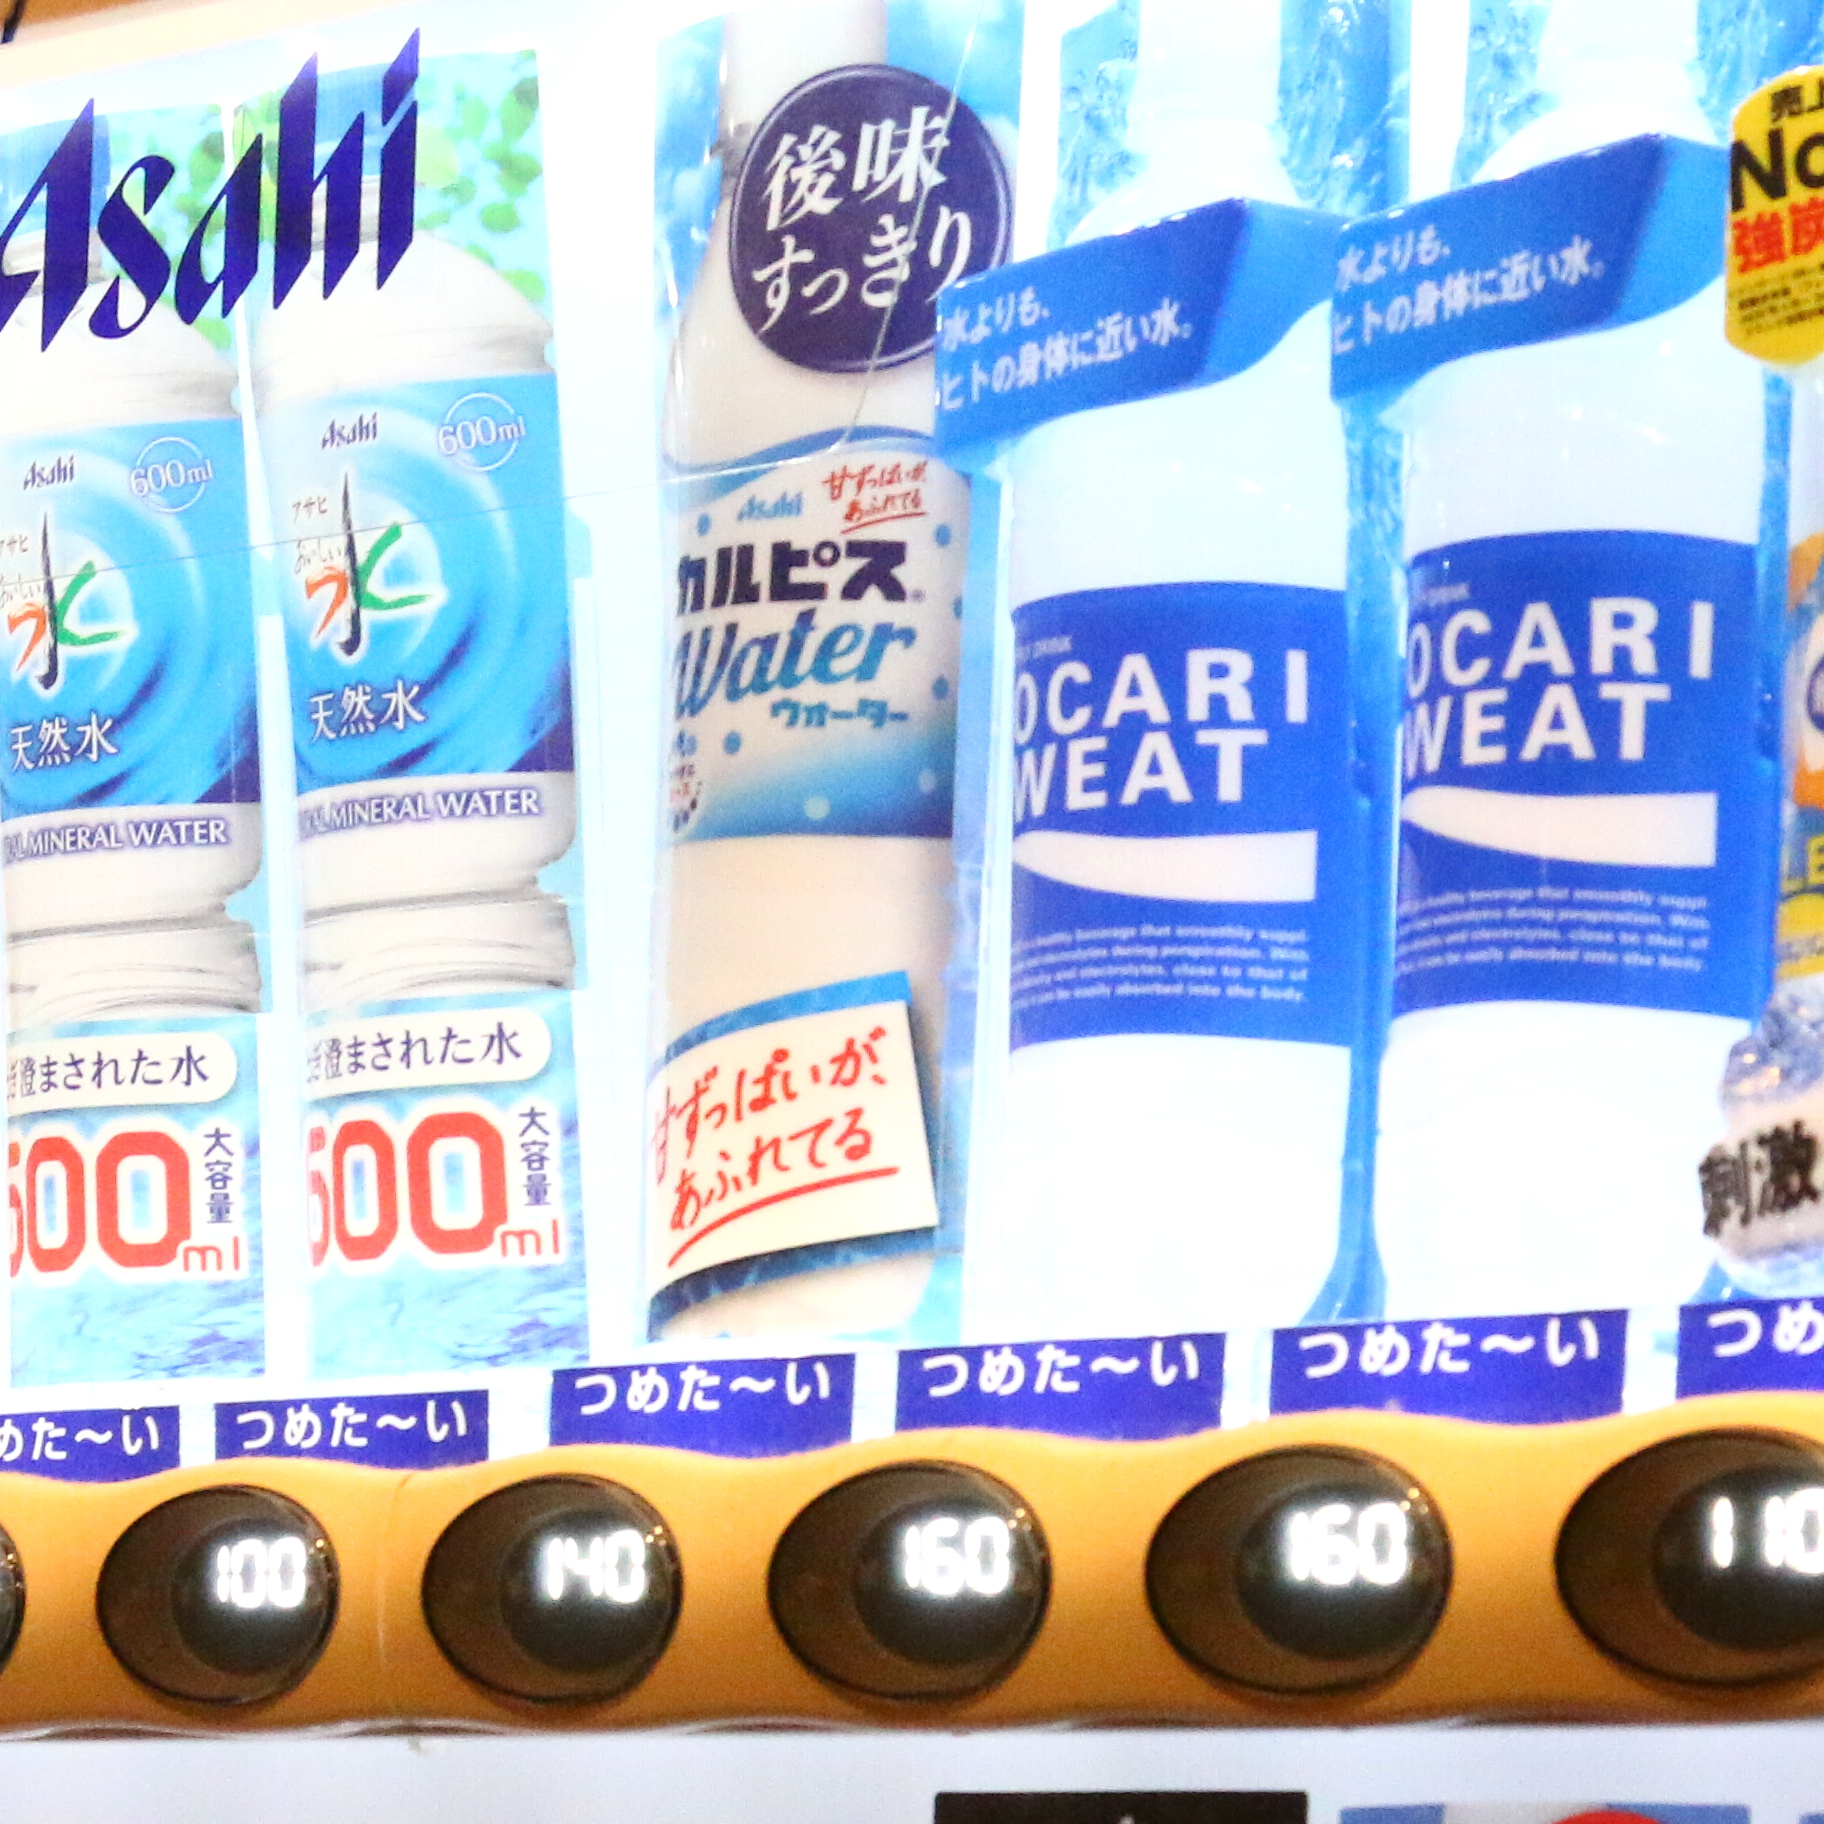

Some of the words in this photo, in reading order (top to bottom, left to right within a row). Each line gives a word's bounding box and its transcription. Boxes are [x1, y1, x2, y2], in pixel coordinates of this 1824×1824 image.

[762, 106, 950, 232] 後味
[753, 205, 972, 334] すっきり
[9, 713, 119, 772] 天然水
[309, 679, 427, 743] 天然水
[129, 819, 227, 847] WATER
[436, 789, 540, 818] WATER
[204, 1127, 234, 1224] 大容量
[518, 1106, 551, 1207] 大容量
[671, 1107, 873, 1232] あふれてる
[217, 1536, 307, 1608] 100
[545, 1529, 647, 1605] 140
[904, 1515, 1012, 1597] 160
[1289, 1501, 1408, 1586] 160
